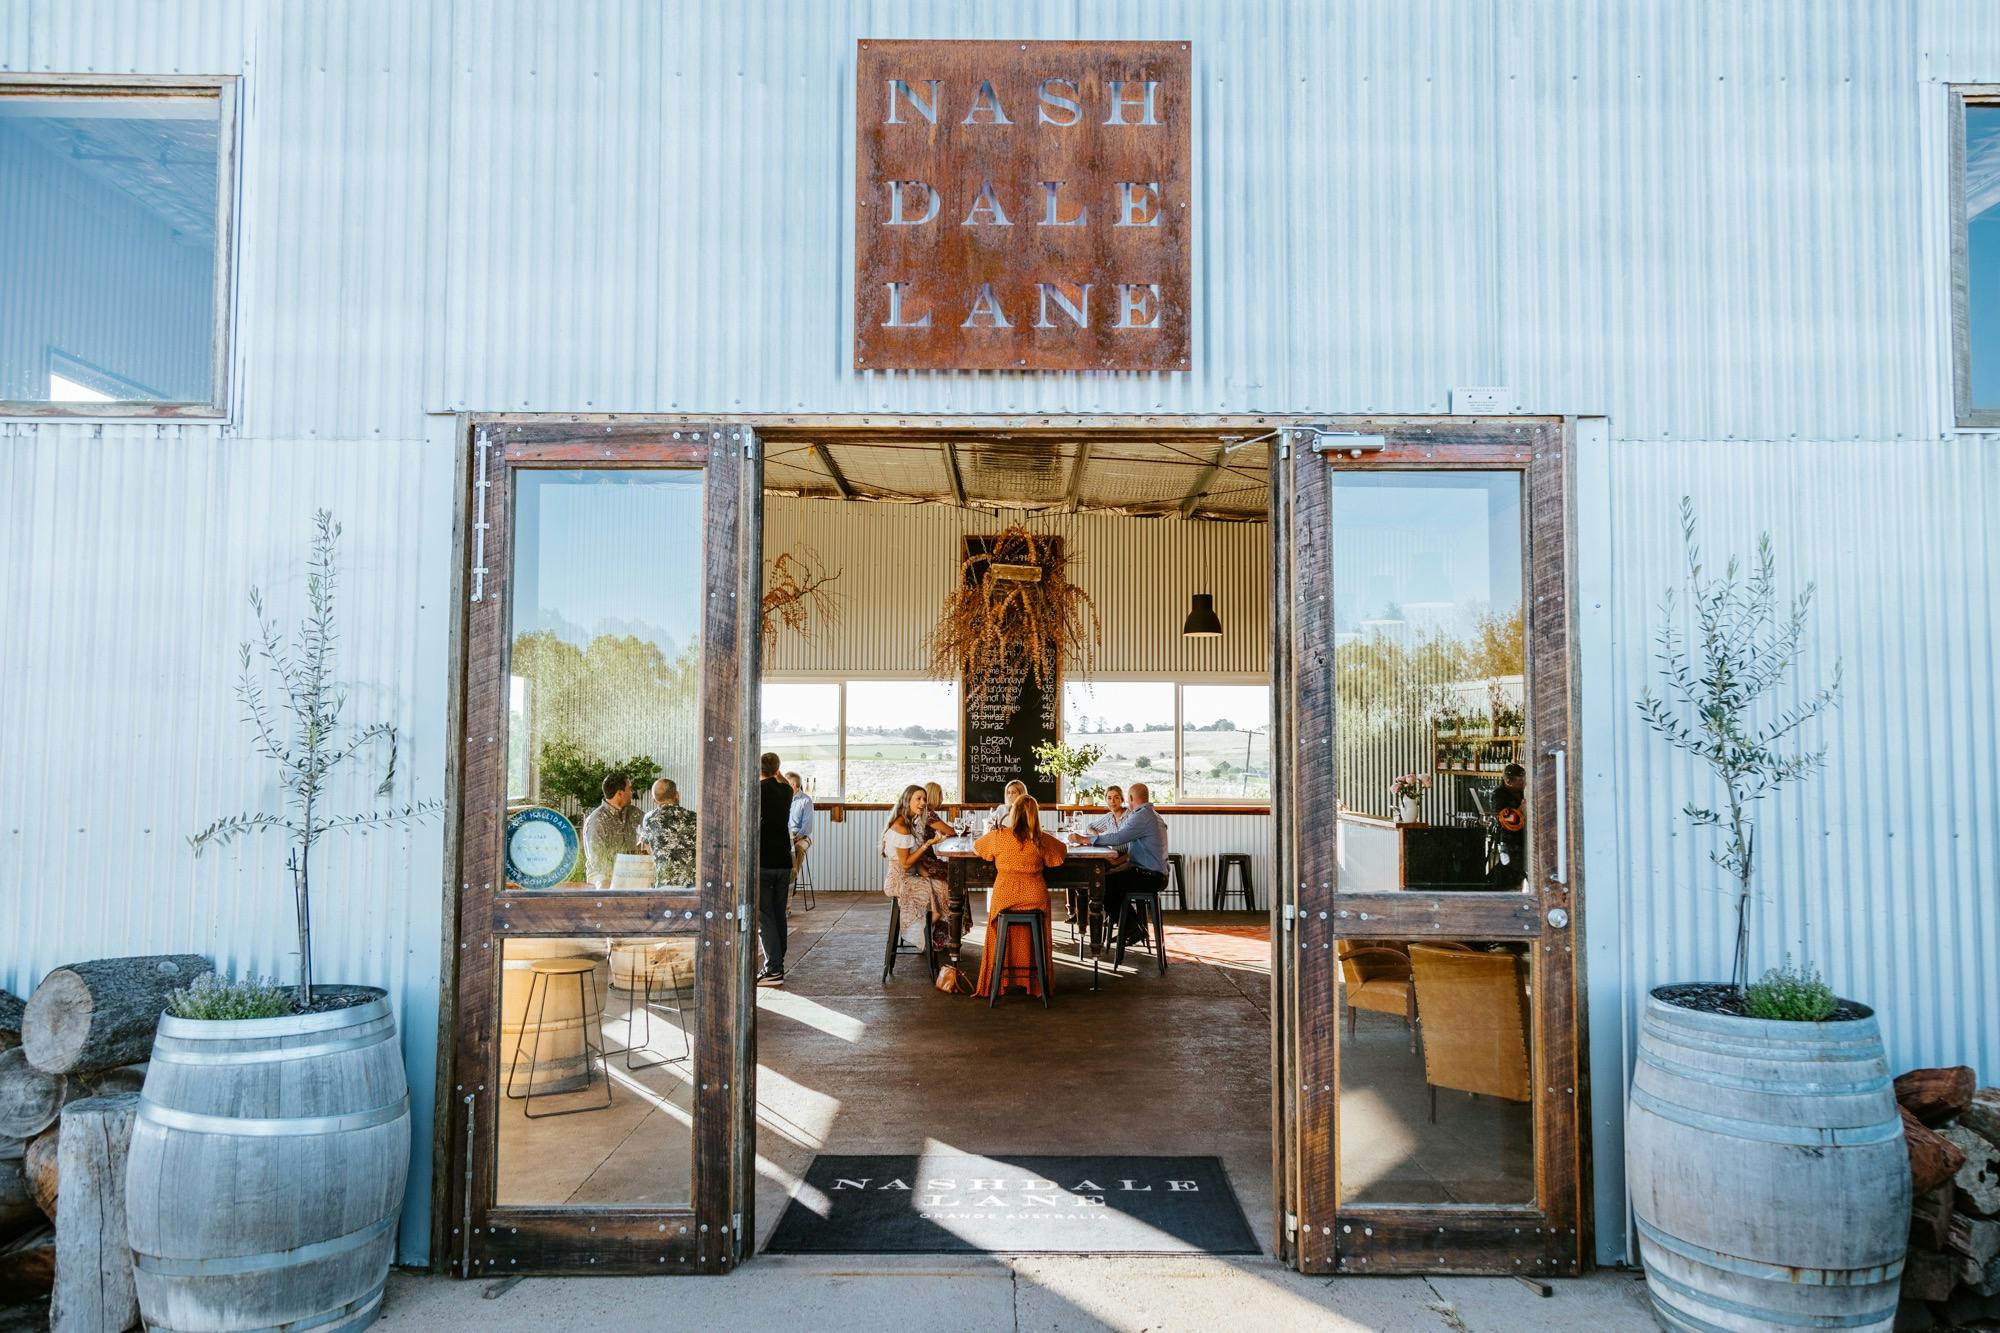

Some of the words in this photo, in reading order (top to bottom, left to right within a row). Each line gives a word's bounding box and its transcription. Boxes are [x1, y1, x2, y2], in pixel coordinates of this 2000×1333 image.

[883, 78, 1164, 127] NASH
[882, 180, 1163, 226] DALE
[881, 282, 1162, 328] LANE
[979, 676, 1021, 688] Cardonnay
[980, 720, 1004, 730] Shiraz
[980, 736, 1013, 748] Legacy
[980, 754, 1002, 764] Pinot
[1004, 754, 1021, 764] Noir
[980, 774, 1006, 783] Shiraz
[529, 812, 567, 829] HALLIDAY
[832, 1178, 1200, 1192] NASHDALE
[923, 1193, 1106, 1208] LANE
